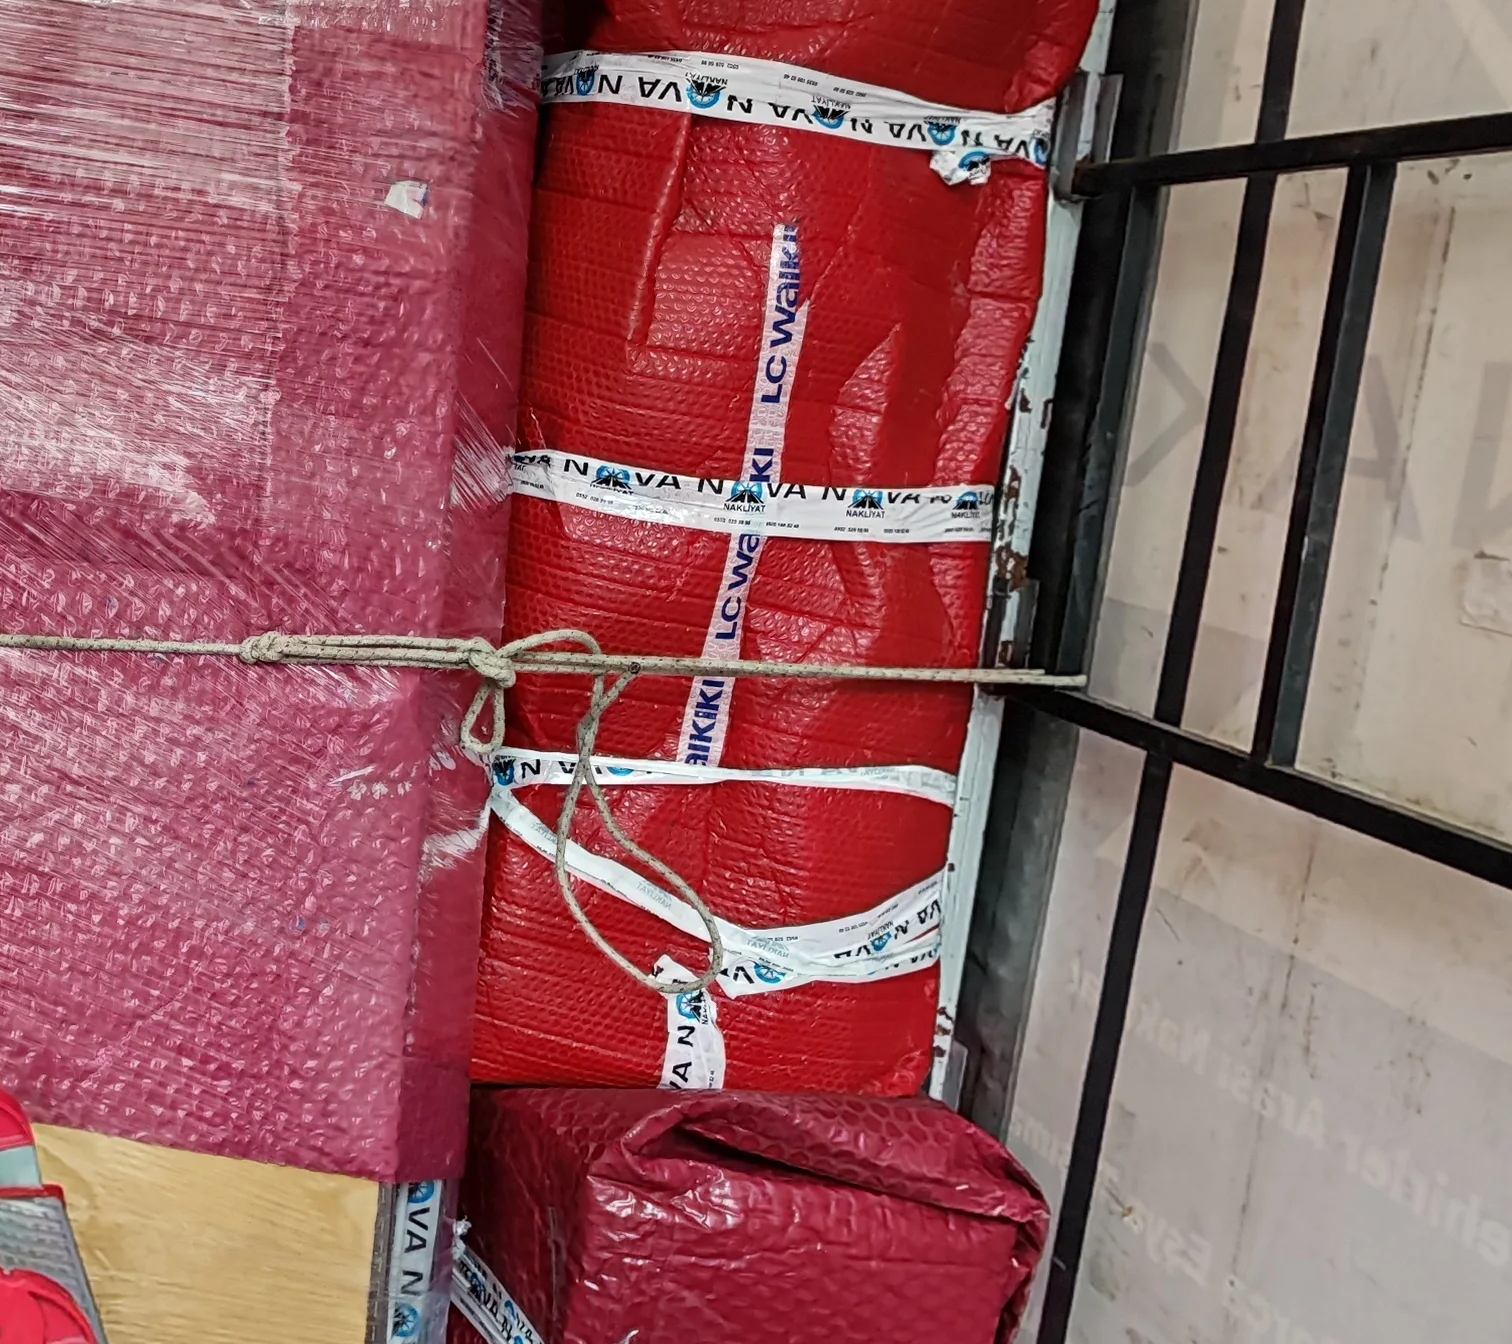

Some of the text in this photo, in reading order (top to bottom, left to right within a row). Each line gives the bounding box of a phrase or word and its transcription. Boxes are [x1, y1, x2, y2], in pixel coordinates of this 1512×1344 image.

[760, 355, 788, 404] LC
[563, 458, 682, 490] NOVA
[696, 478, 807, 502] NOVA
[723, 502, 766, 514] NAKLİYAT
[846, 508, 887, 519] NAKLİYAT
[715, 597, 742, 641] LC
